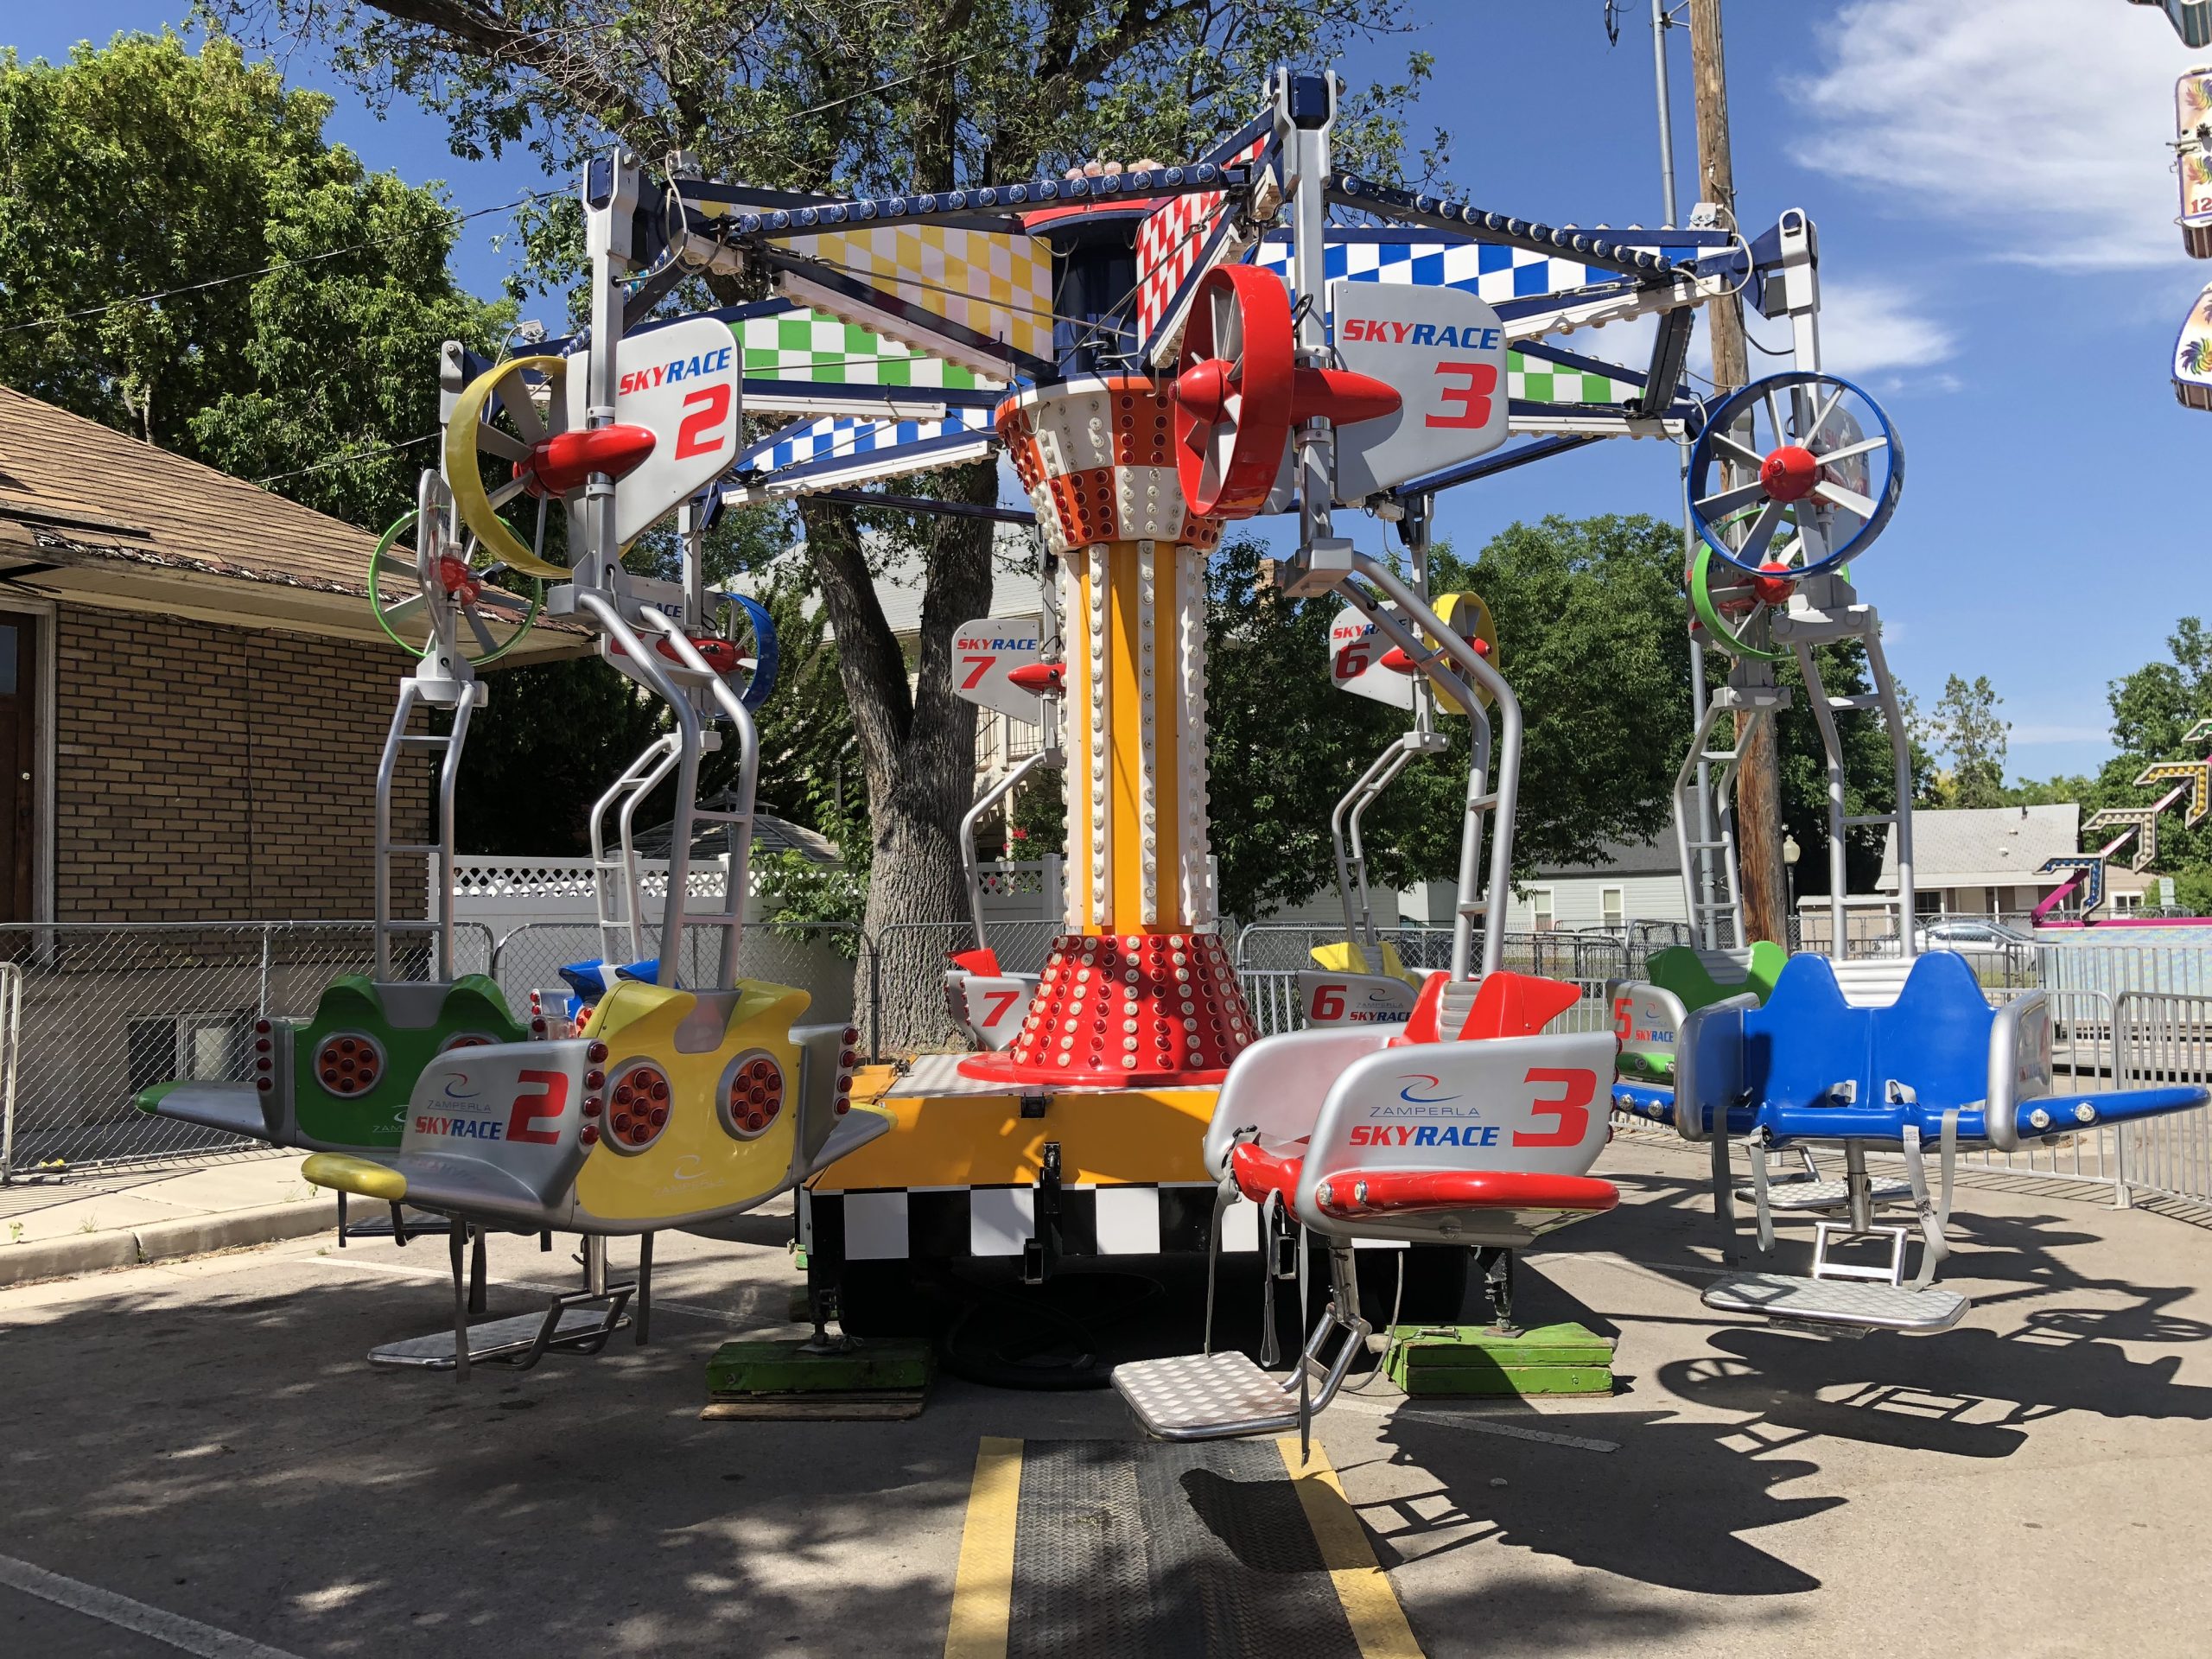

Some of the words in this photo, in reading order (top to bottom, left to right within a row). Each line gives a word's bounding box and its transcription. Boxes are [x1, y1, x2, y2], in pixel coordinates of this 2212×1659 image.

[1343, 319, 1501, 350] SKYRACE
[619, 346, 732, 396] SKYRACE
[1425, 361, 1497, 429] 3
[674, 384, 731, 461] 2
[957, 639, 1038, 651] SKYRACE
[1335, 642, 1370, 679] 6
[960, 656, 996, 690] 7
[982, 990, 1020, 1027] 7
[1311, 984, 1347, 1021] 6
[1614, 998, 1632, 1040] 5
[1635, 1029, 1675, 1043] SKYRACE
[427, 1099, 492, 1112] ZAMPERLA
[505, 1070, 569, 1146] 2
[1370, 1106, 1481, 1117] ZAMPERLA
[1512, 1067, 1597, 1147] 3
[415, 1116, 503, 1141] SKYRACE
[1349, 1126, 1500, 1147] SKYRACE
